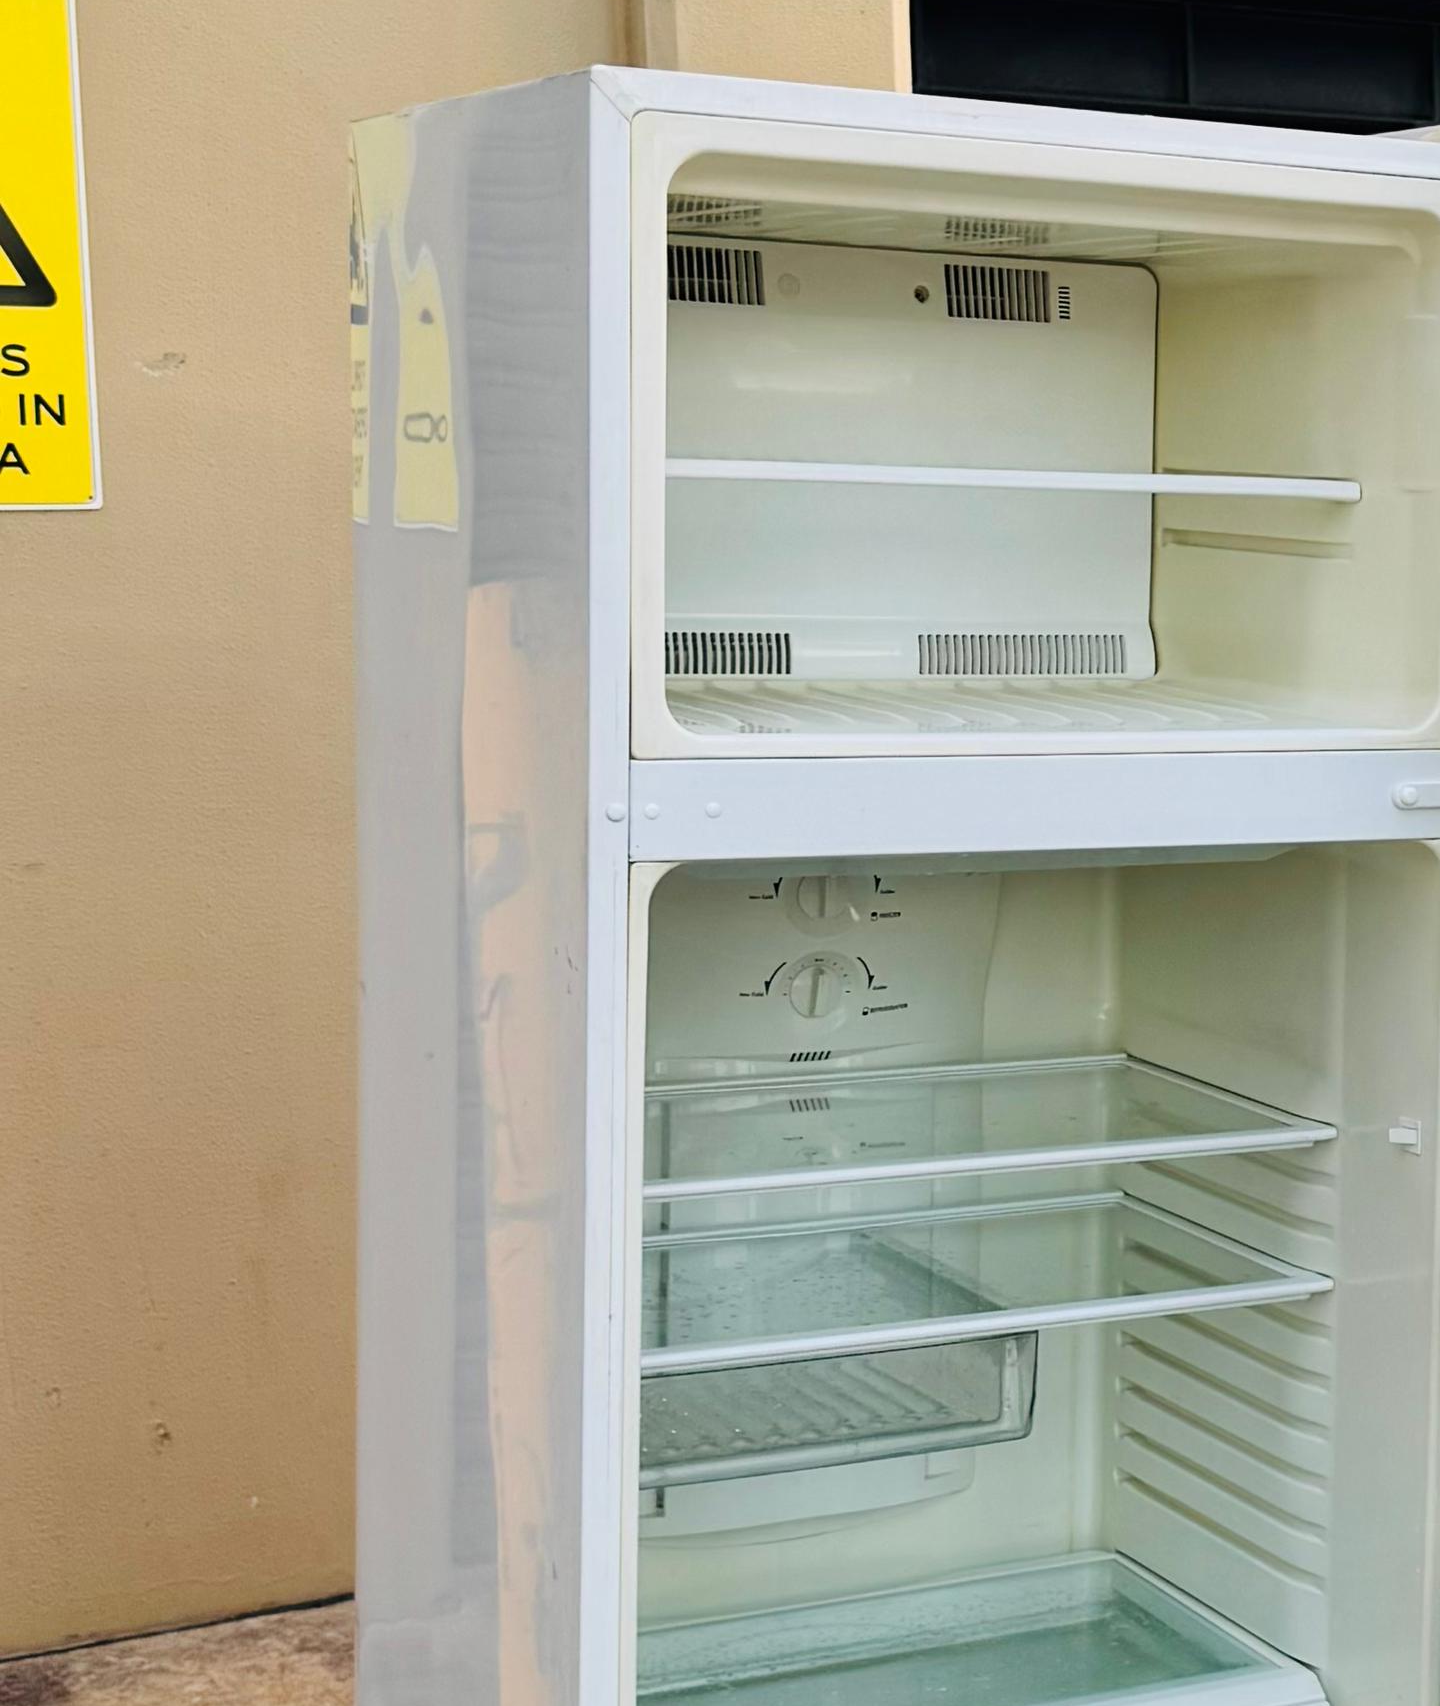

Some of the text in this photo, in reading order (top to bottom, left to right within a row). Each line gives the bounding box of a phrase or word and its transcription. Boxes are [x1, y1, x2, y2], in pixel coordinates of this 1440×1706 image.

[1, 344, 30, 377] S
[18, 393, 66, 426] IN
[0, 442, 31, 475] A
